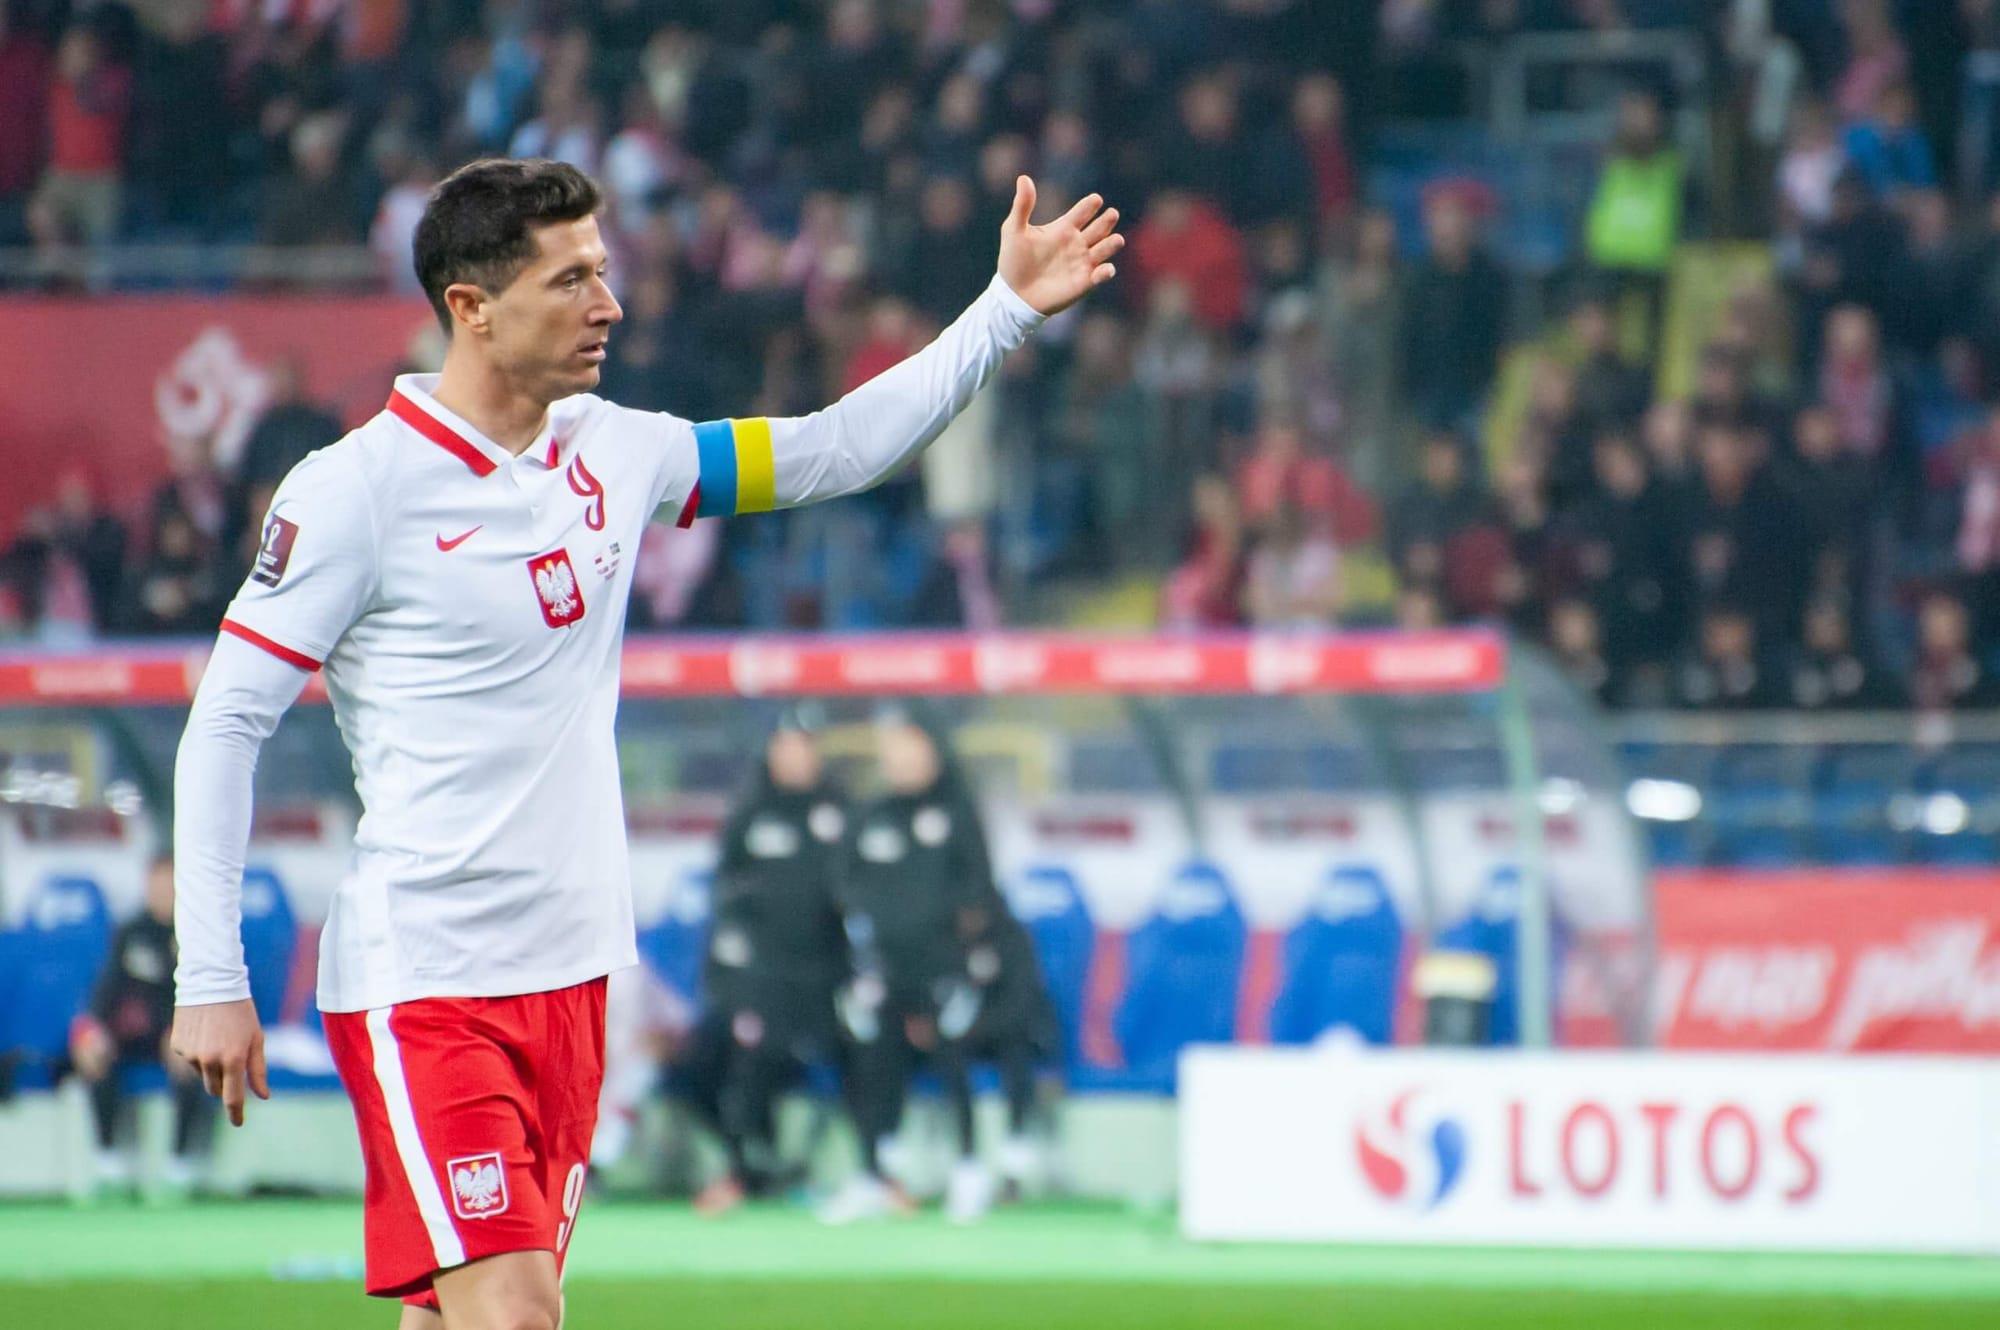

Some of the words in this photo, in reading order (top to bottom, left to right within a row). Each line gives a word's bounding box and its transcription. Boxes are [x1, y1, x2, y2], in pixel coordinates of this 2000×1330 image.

[566, 451, 605, 531] 9
[1507, 1100, 1821, 1204] LOTOS
[556, 1162, 584, 1253] 9
